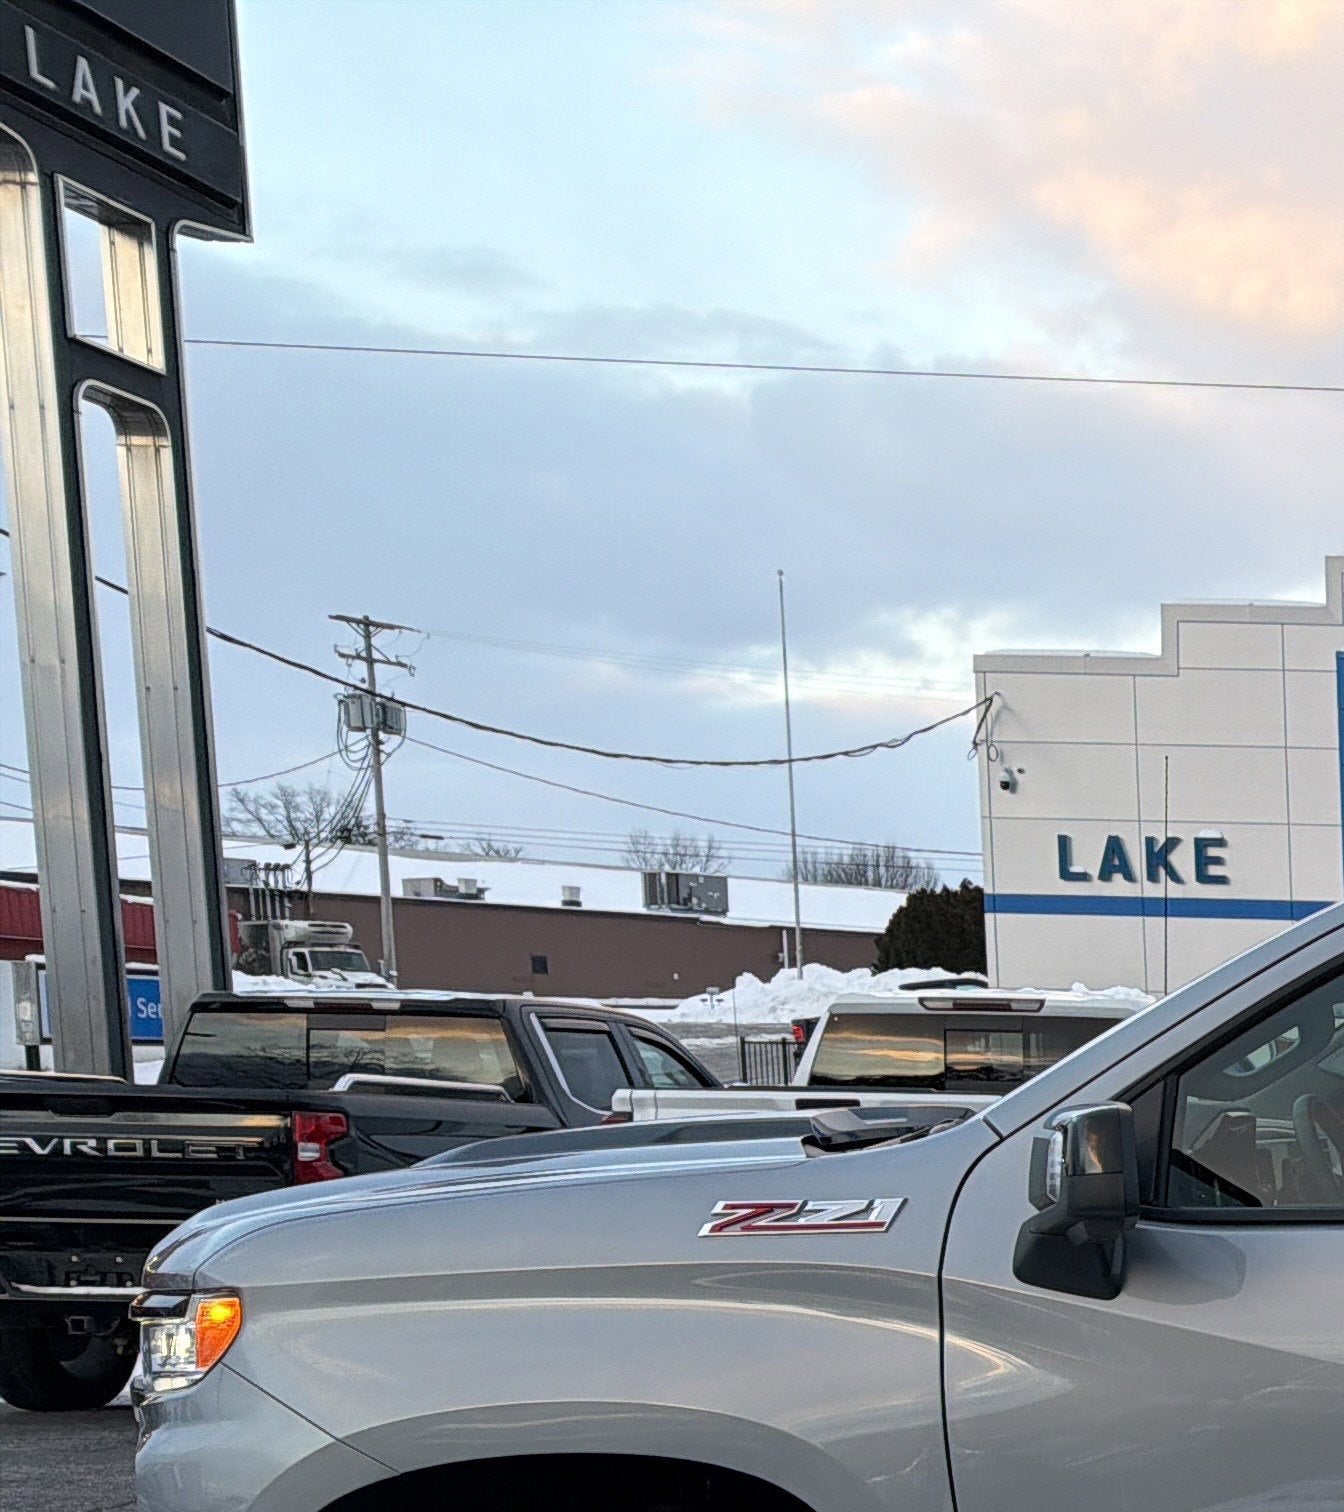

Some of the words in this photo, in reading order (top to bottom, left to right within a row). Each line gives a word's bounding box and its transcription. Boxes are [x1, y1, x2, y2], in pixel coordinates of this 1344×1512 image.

[24, 24, 188, 162] LAKE
[1056, 833, 1232, 886] LAKE
[697, 1197, 907, 1237] Z71
